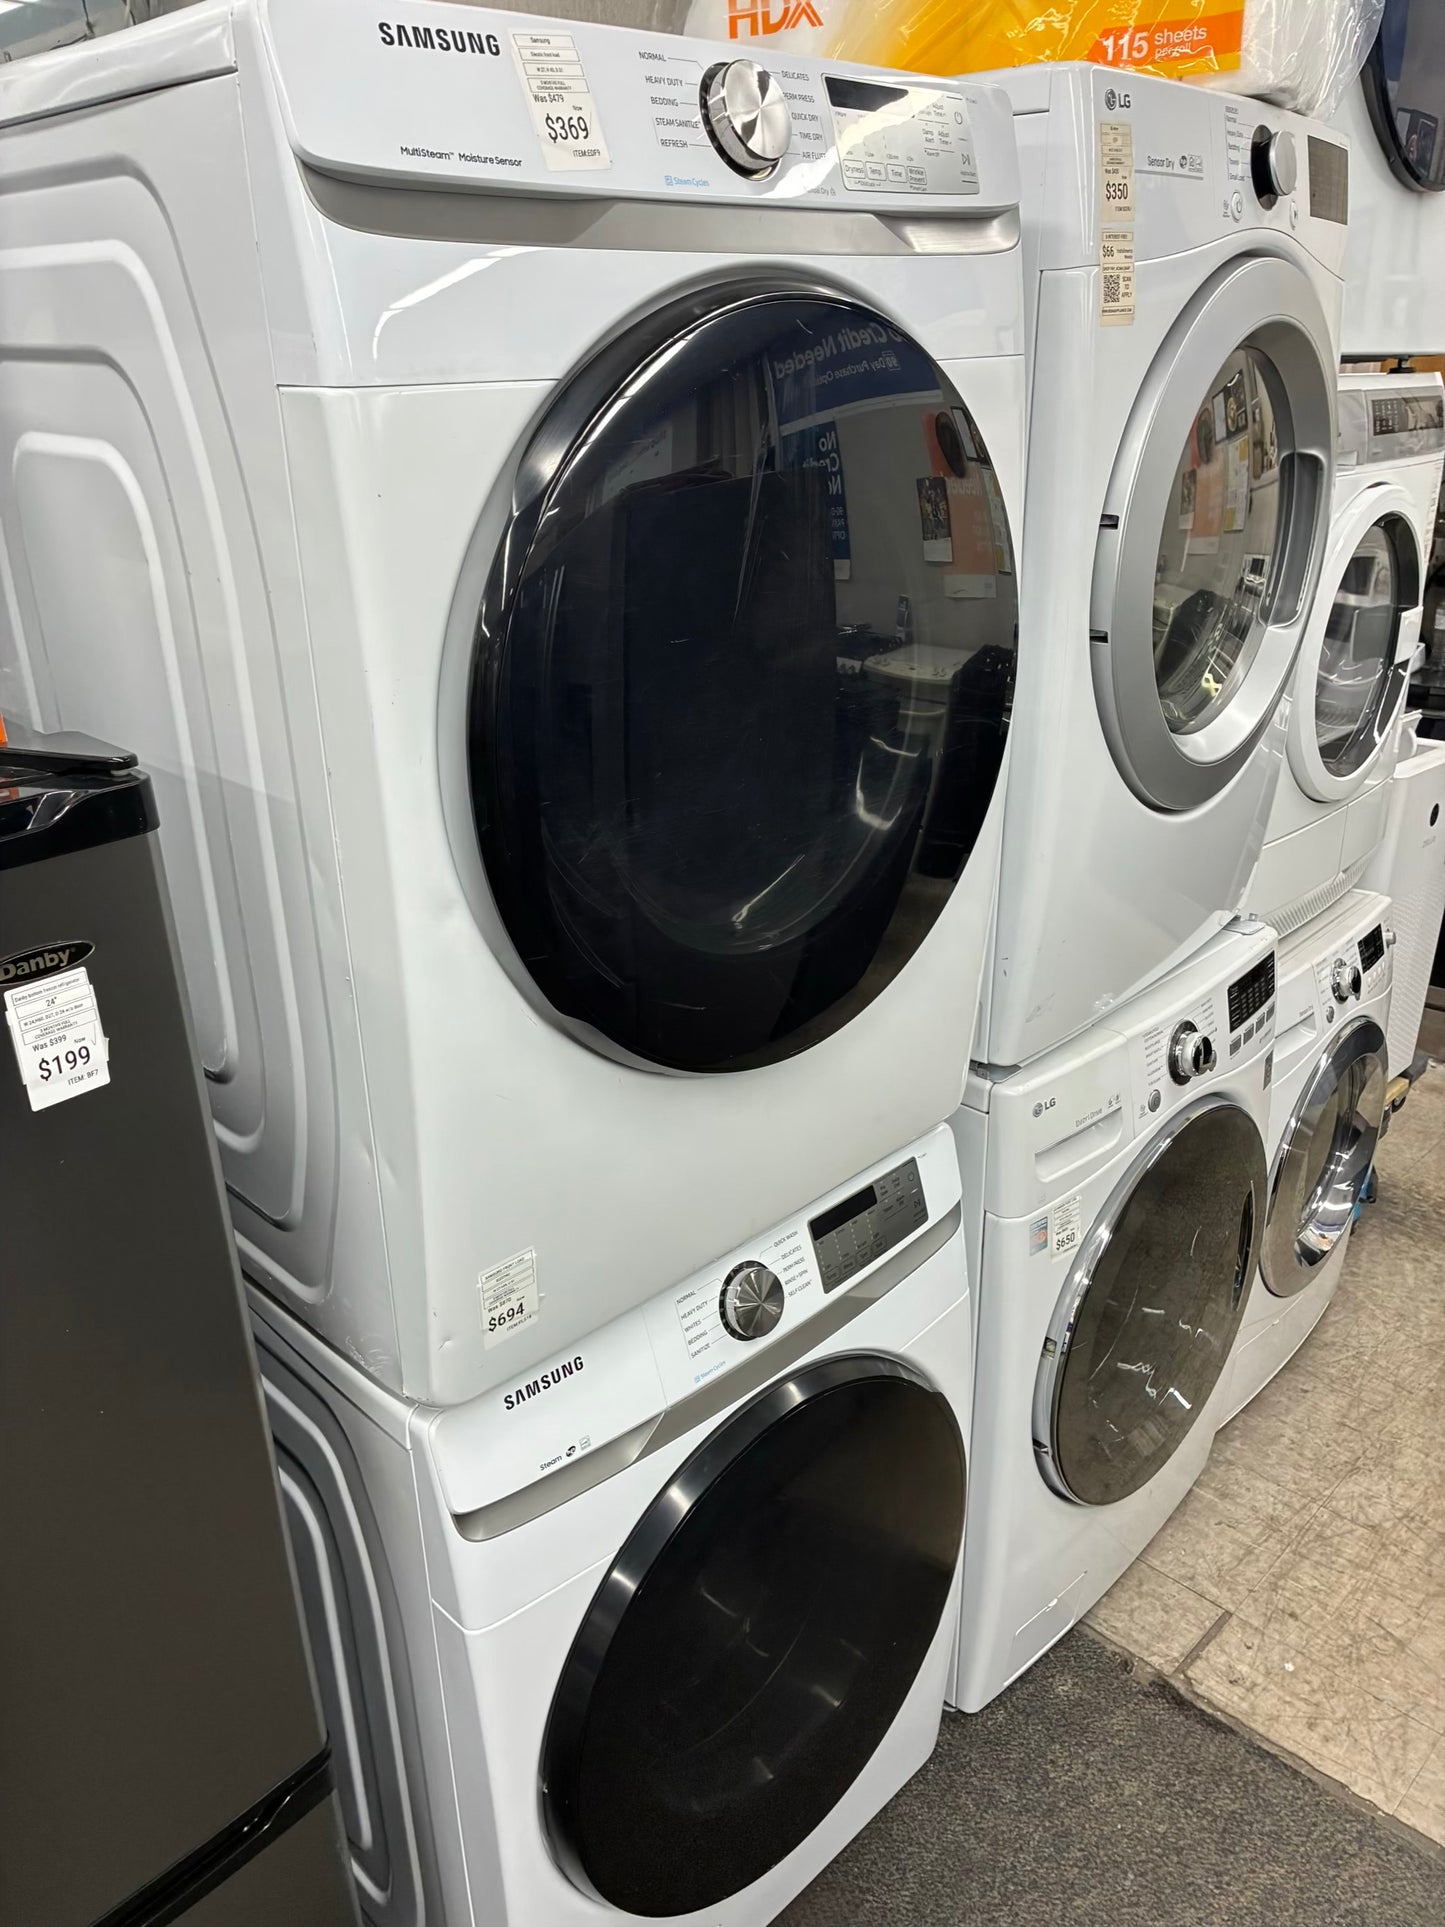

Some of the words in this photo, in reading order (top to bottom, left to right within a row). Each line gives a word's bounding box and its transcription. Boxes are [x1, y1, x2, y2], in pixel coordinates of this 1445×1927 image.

[728, 0, 824, 40] HDX
[378, 21, 501, 57] SAMSUNG
[1101, 31, 1150, 62] 115
[1154, 26, 1208, 45] sheets
[638, 51, 667, 62] NORMAL
[645, 75, 666, 85] HEAVY
[667, 77, 683, 87] DUTY
[781, 70, 810, 81] DELICATES
[532, 94, 548, 103] Was
[548, 92, 564, 104] $479
[650, 96, 679, 107] BEDDING
[798, 94, 815, 104] PRESS
[1118, 94, 1131, 108] LG
[655, 117, 675, 127] STEAM
[791, 112, 807, 121] QUICK
[808, 113, 819, 122] DRY
[545, 113, 589, 144] $369
[660, 138, 689, 148] REFRESH
[799, 132, 812, 140] TIME
[812, 132, 824, 141] DRY
[458, 152, 494, 166] Moisture
[494, 156, 522, 167] Sensor
[1147, 156, 1165, 168] Sensor
[1166, 158, 1175, 170] Dry
[891, 169, 902, 178] Time
[673, 176, 692, 186] Steam
[692, 178, 710, 188] Cycles
[1106, 180, 1128, 202] $350
[1102, 244, 1114, 258] $66
[0, 948, 70, 981] Danby
[14, 994, 28, 1003] Danby
[32, 1042, 48, 1052] Was
[50, 1034, 67, 1046] $399
[38, 1045, 91, 1082] $199
[68, 1074, 85, 1086] ITEM:
[1044, 1097, 1056, 1111] LG
[773, 1238, 786, 1248] QUICK
[786, 1230, 799, 1240] WASH
[1056, 1232, 1076, 1251] $650
[780, 1244, 802, 1260] DELICATES
[782, 1264, 793, 1273] PERM
[792, 1256, 806, 1268] PRESS
[676, 1290, 696, 1305] NORMAL
[788, 1289, 798, 1298] SELF
[488, 1305, 498, 1313] Was
[680, 1308, 696, 1320] HEAVY
[696, 1300, 708, 1311] DUTY
[488, 1302, 525, 1332] $694
[684, 1320, 702, 1333] WHITES
[688, 1330, 708, 1346] BEDDING
[690, 1342, 711, 1359] SANITIZE
[504, 1356, 584, 1411] SAMSUNG
[540, 1455, 562, 1472] Steam
